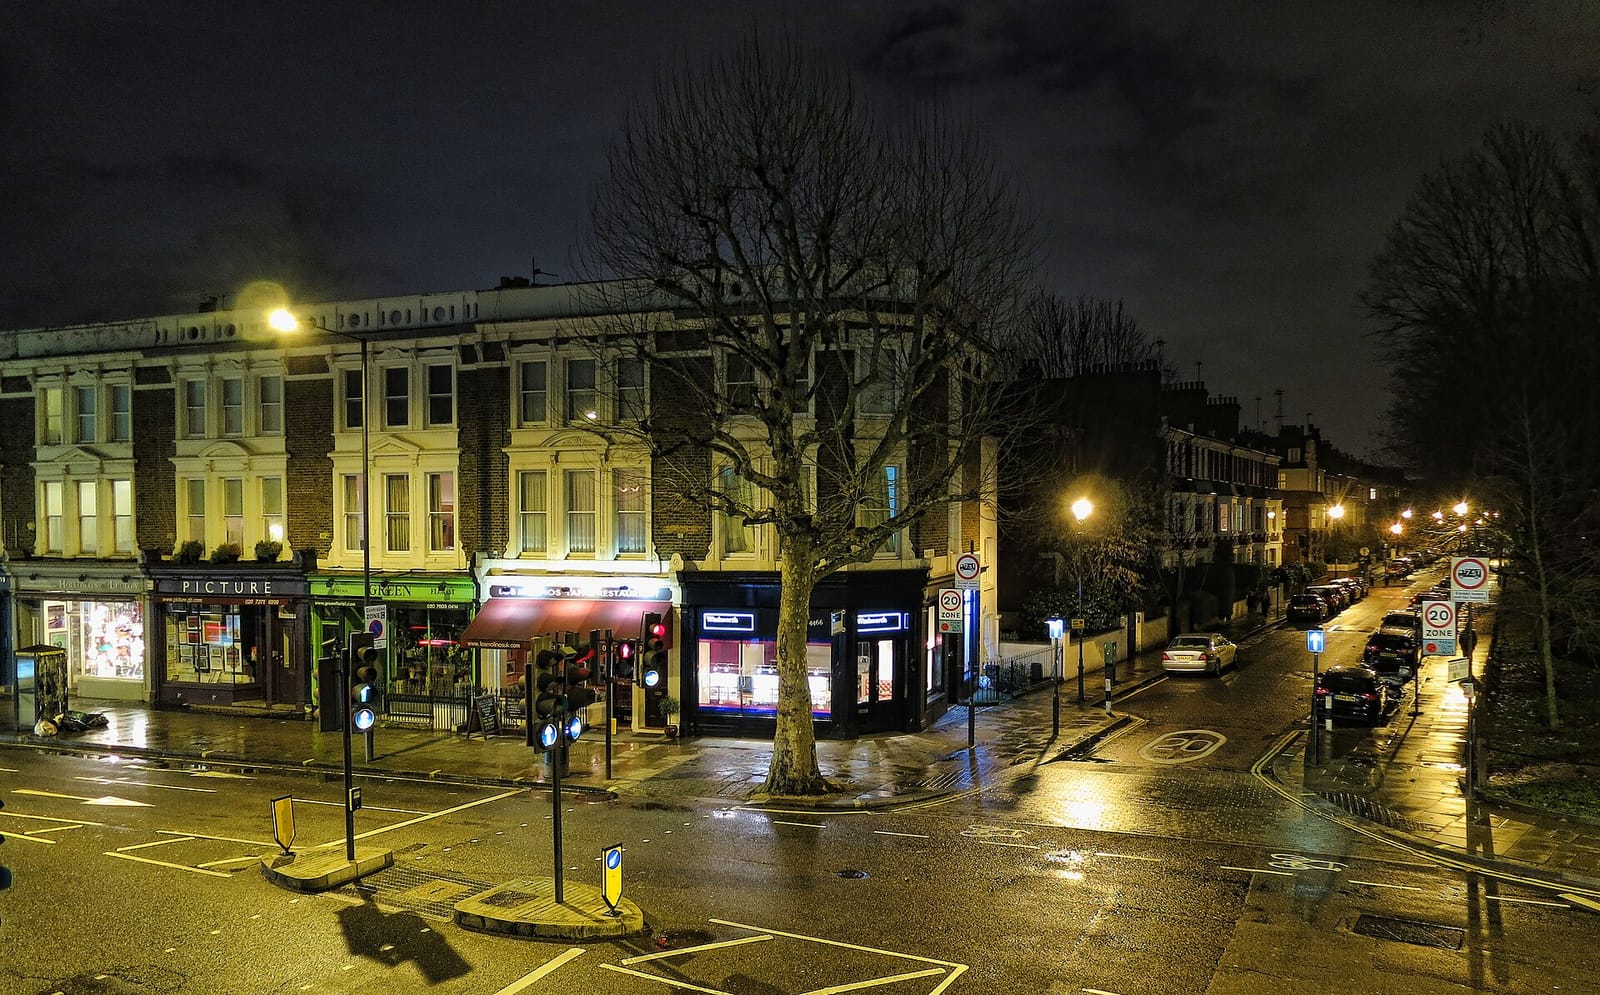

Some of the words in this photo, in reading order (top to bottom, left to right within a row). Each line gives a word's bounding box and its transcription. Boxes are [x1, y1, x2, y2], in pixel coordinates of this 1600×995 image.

[182, 581, 272, 594] PICTURE
[369, 584, 412, 596] GREEN
[944, 596, 958, 605] 20
[1429, 610, 1449, 621] 20
[808, 618, 824, 626] 4466
[1152, 737, 1214, 753] 20
